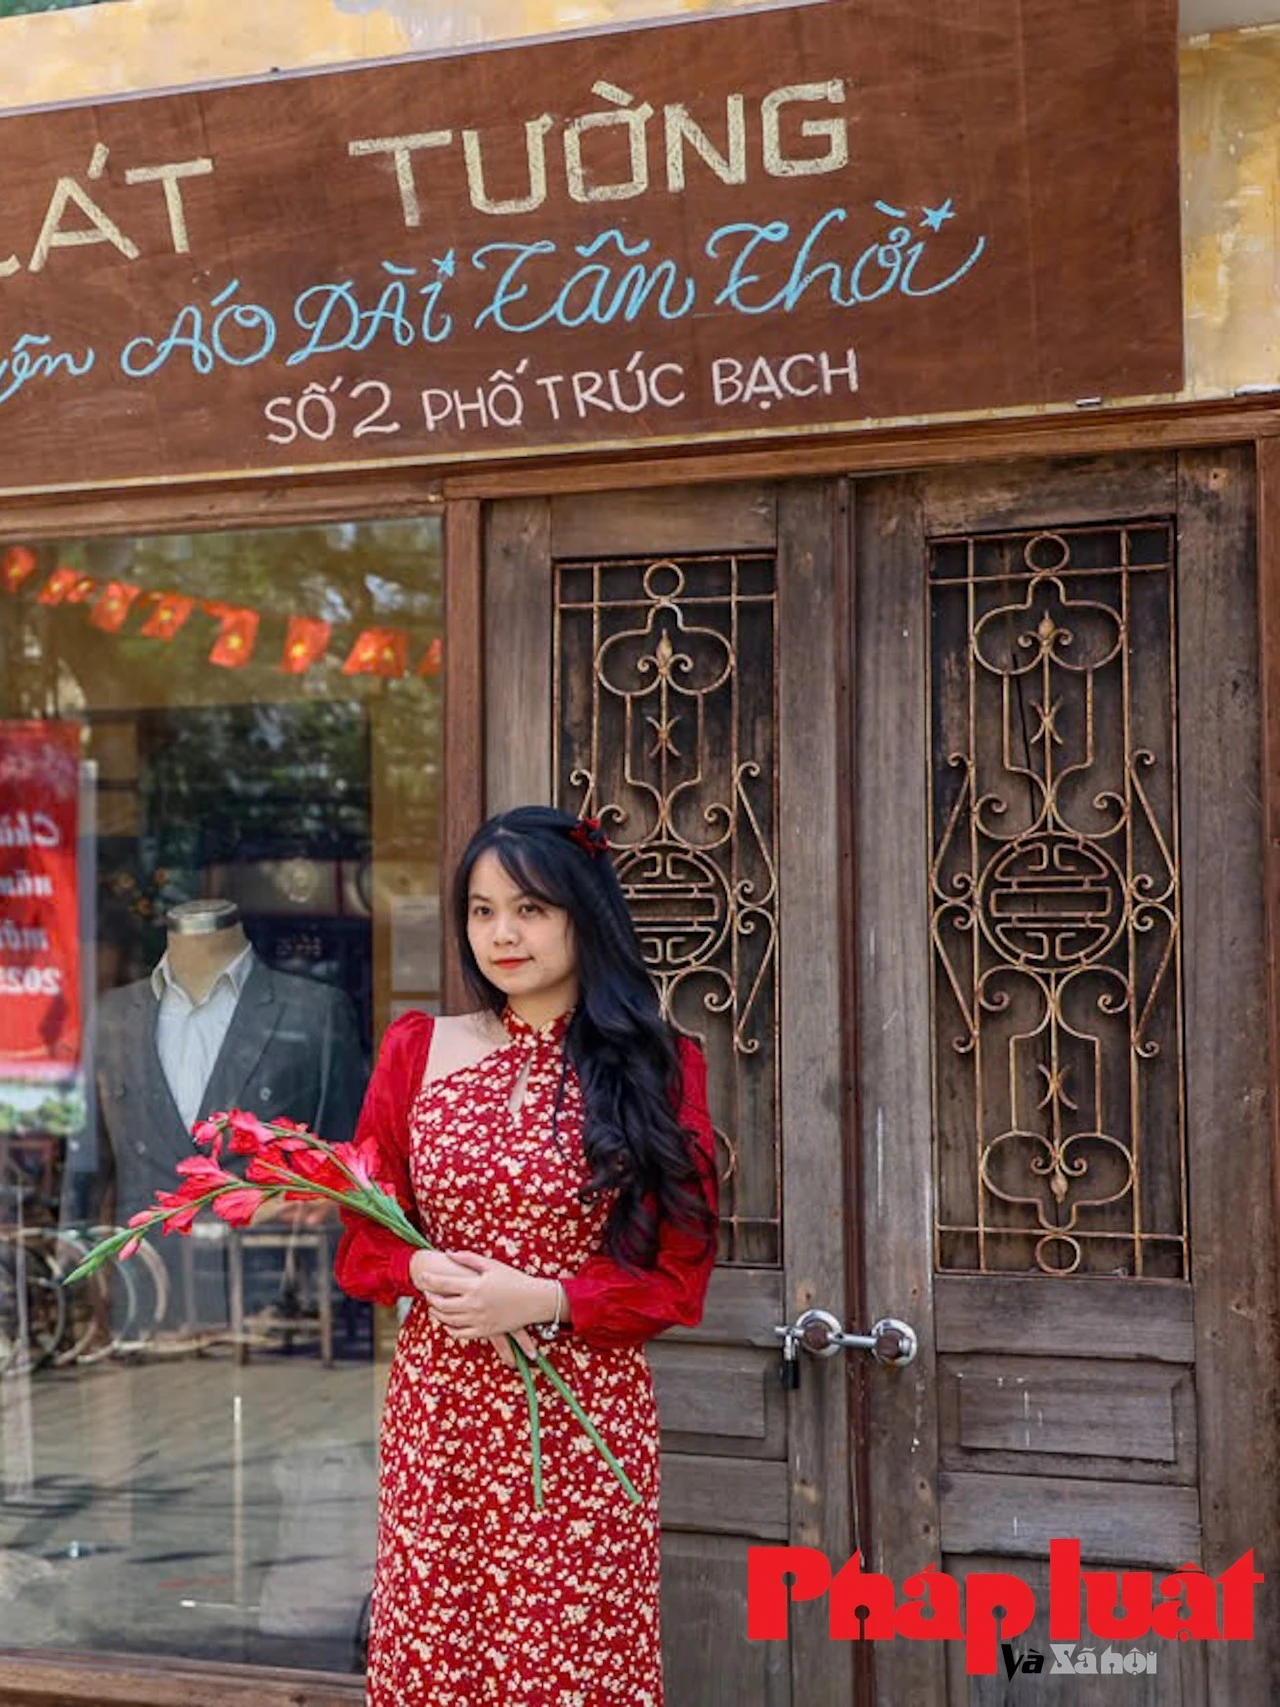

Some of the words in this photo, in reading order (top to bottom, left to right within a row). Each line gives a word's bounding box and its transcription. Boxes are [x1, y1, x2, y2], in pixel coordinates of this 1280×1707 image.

[347, 79, 849, 227] TƯỜNG
[472, 228, 697, 332] Tân
[263, 375, 344, 445] SỐ
[348, 379, 401, 439] 2
[420, 357, 530, 433] PHỐ
[535, 350, 687, 421] TRÚC
[711, 348, 860, 411] BẠCH
